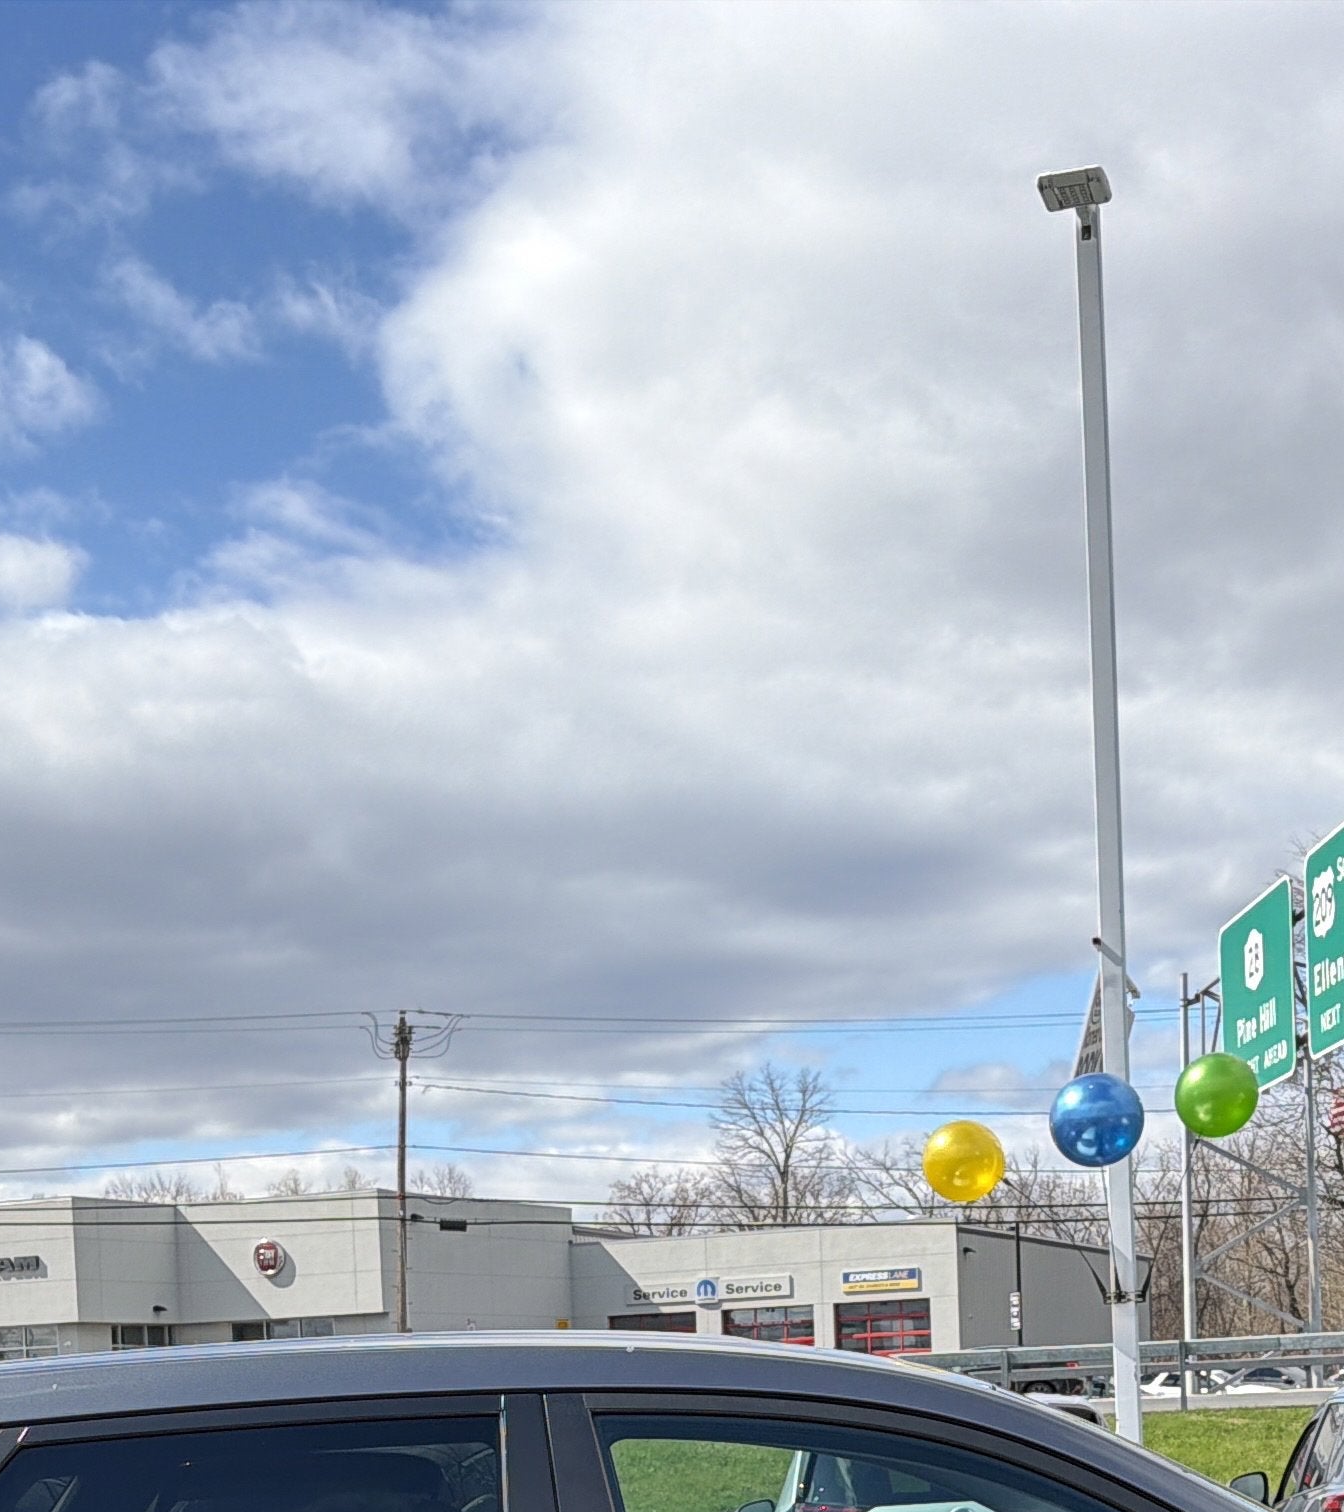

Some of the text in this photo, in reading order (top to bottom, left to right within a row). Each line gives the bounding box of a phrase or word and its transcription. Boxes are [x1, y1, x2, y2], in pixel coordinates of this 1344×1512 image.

[1314, 883, 1335, 928] 209
[1236, 997, 1277, 1048] Pine Hill
[1320, 1003, 1341, 1033] NEXT
[632, 1288, 688, 1301] Service
[725, 1281, 783, 1295] Service
